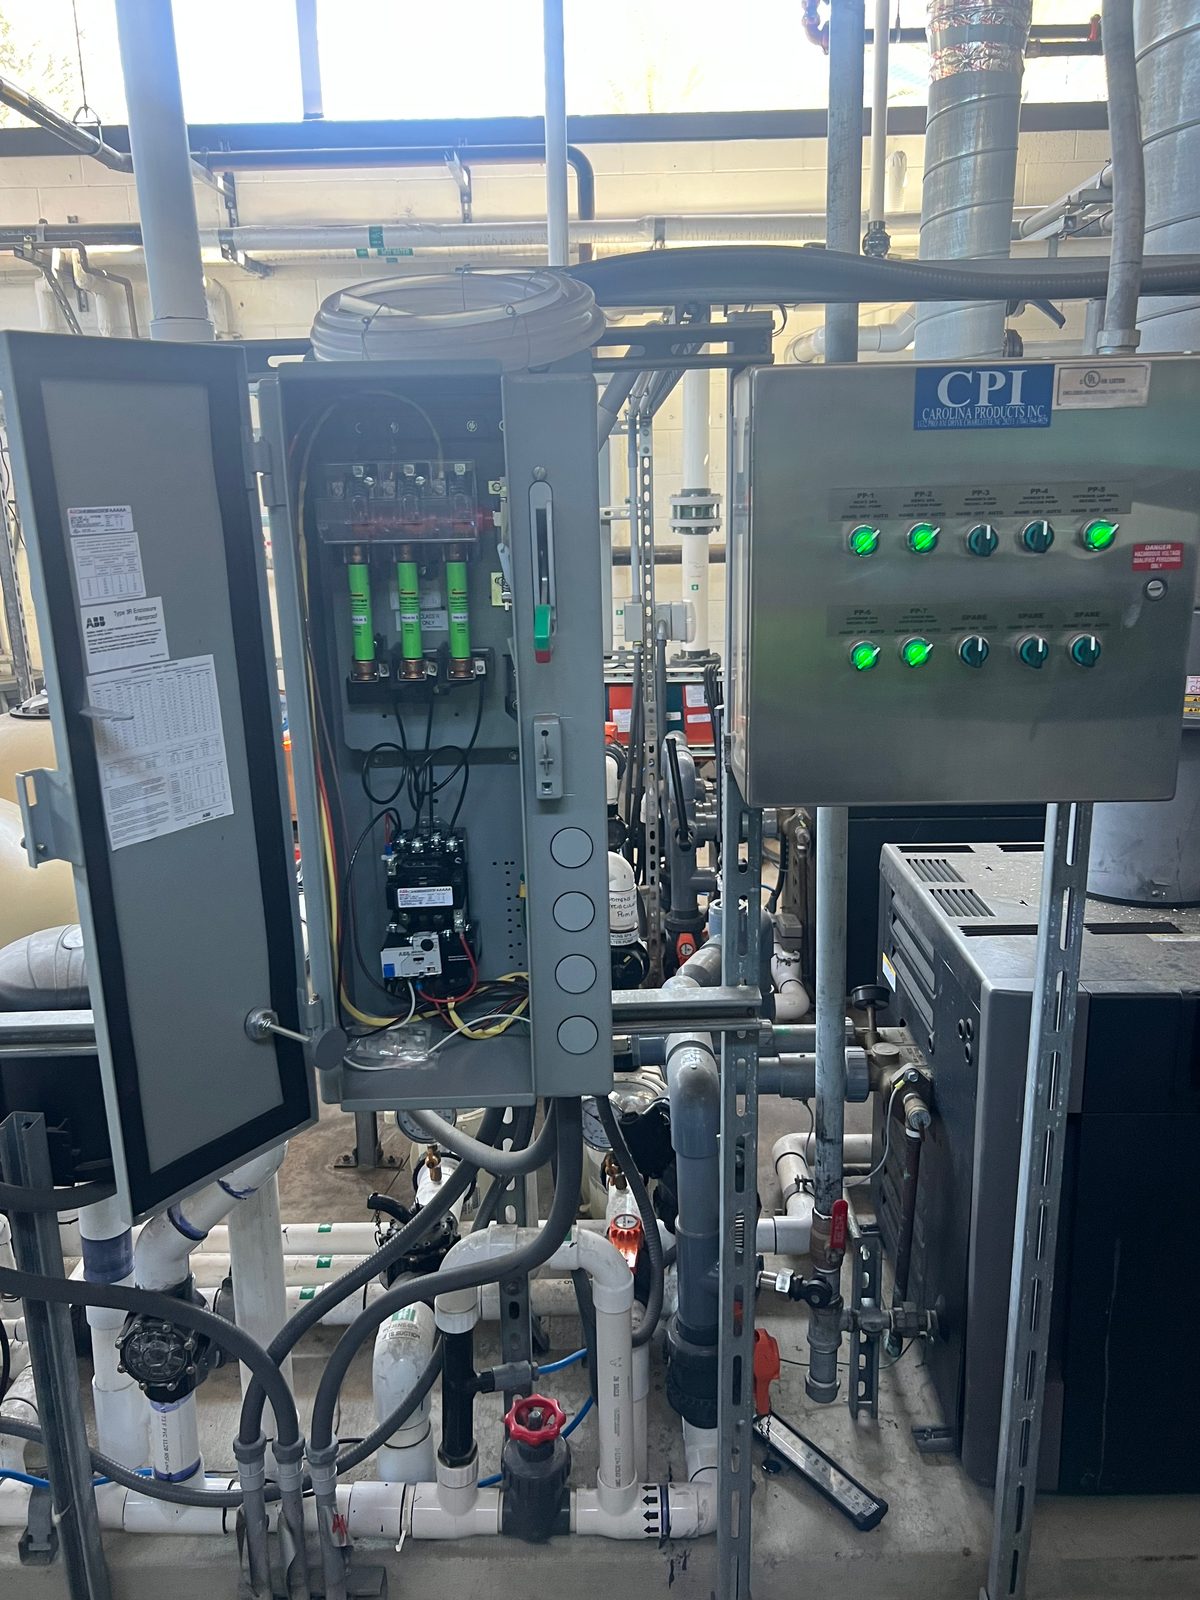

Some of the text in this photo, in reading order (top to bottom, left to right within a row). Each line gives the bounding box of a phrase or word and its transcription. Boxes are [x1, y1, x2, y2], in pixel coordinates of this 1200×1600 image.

[937, 369, 1027, 408] CPI
[922, 407, 972, 420] CAROLINA
[974, 406, 1026, 419] PRODUCTS
[86, 616, 106, 629] ABB
